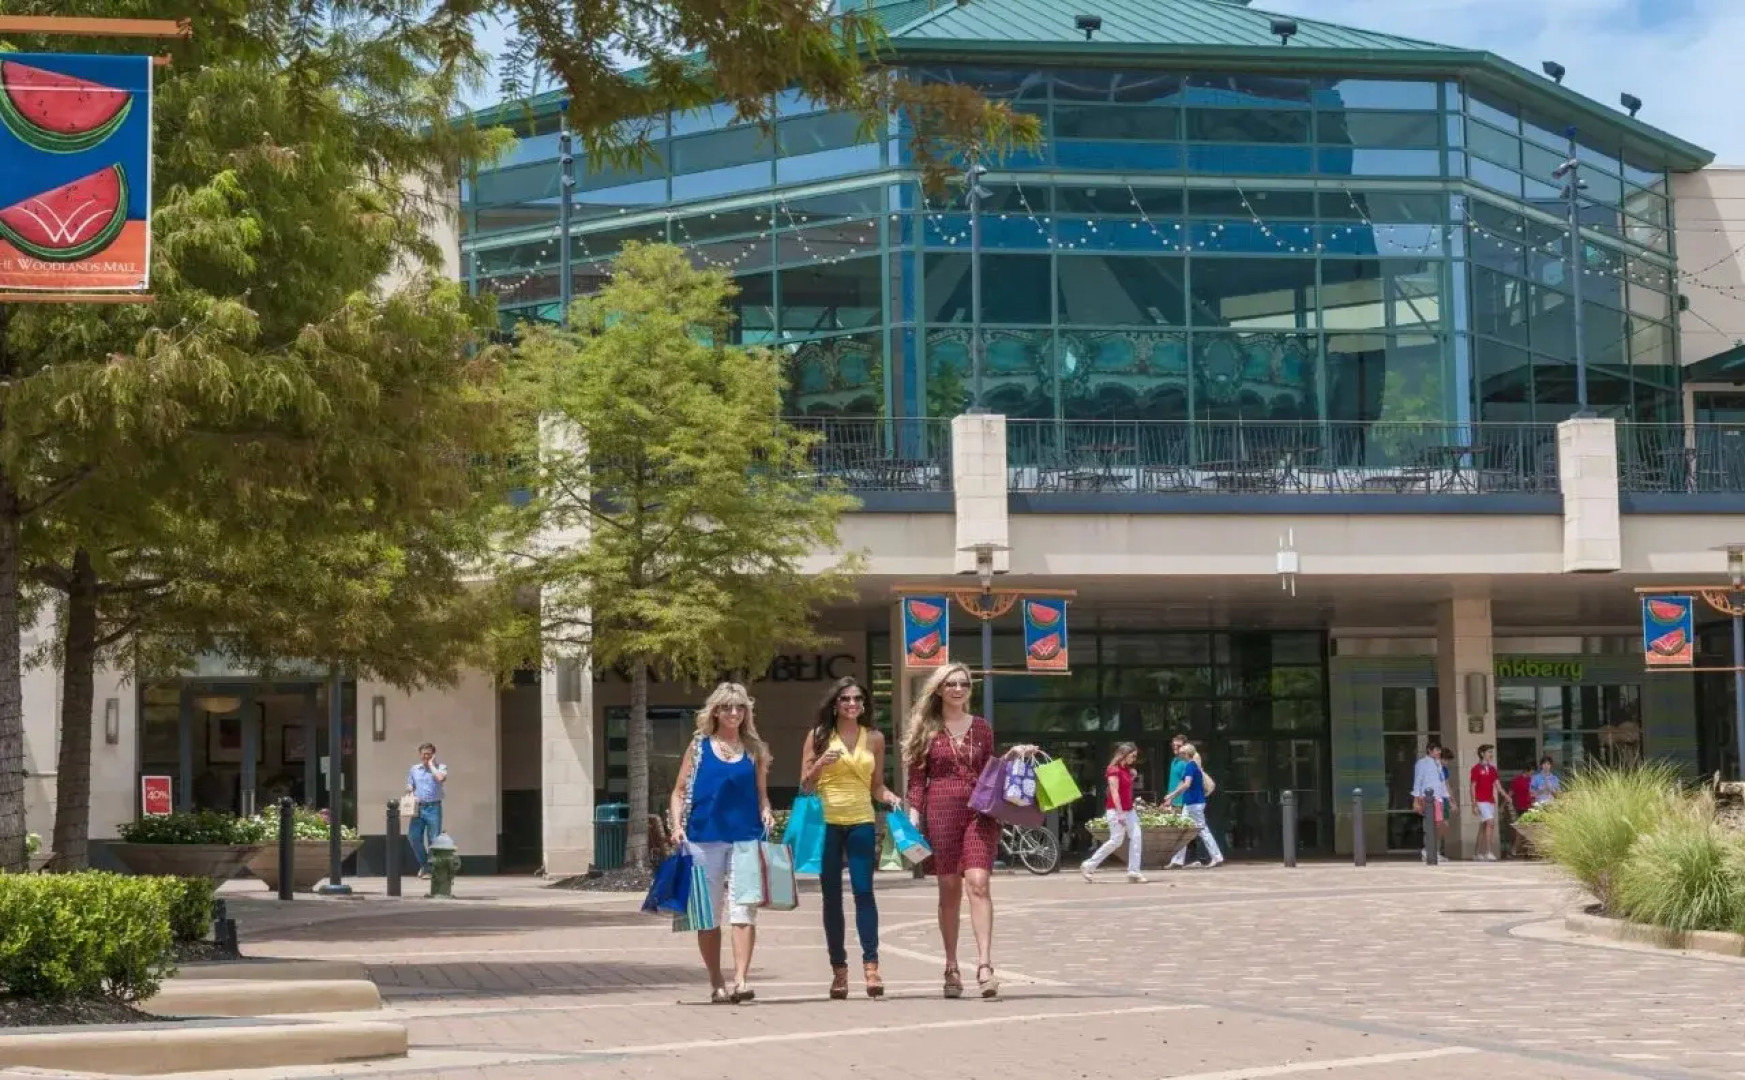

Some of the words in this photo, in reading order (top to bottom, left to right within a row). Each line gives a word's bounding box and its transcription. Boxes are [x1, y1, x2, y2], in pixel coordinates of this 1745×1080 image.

[0, 258, 12, 271] HE
[18, 258, 100, 272] WOODLANDS
[103, 261, 140, 272] MALL
[1494, 660, 1582, 682] inkberry
